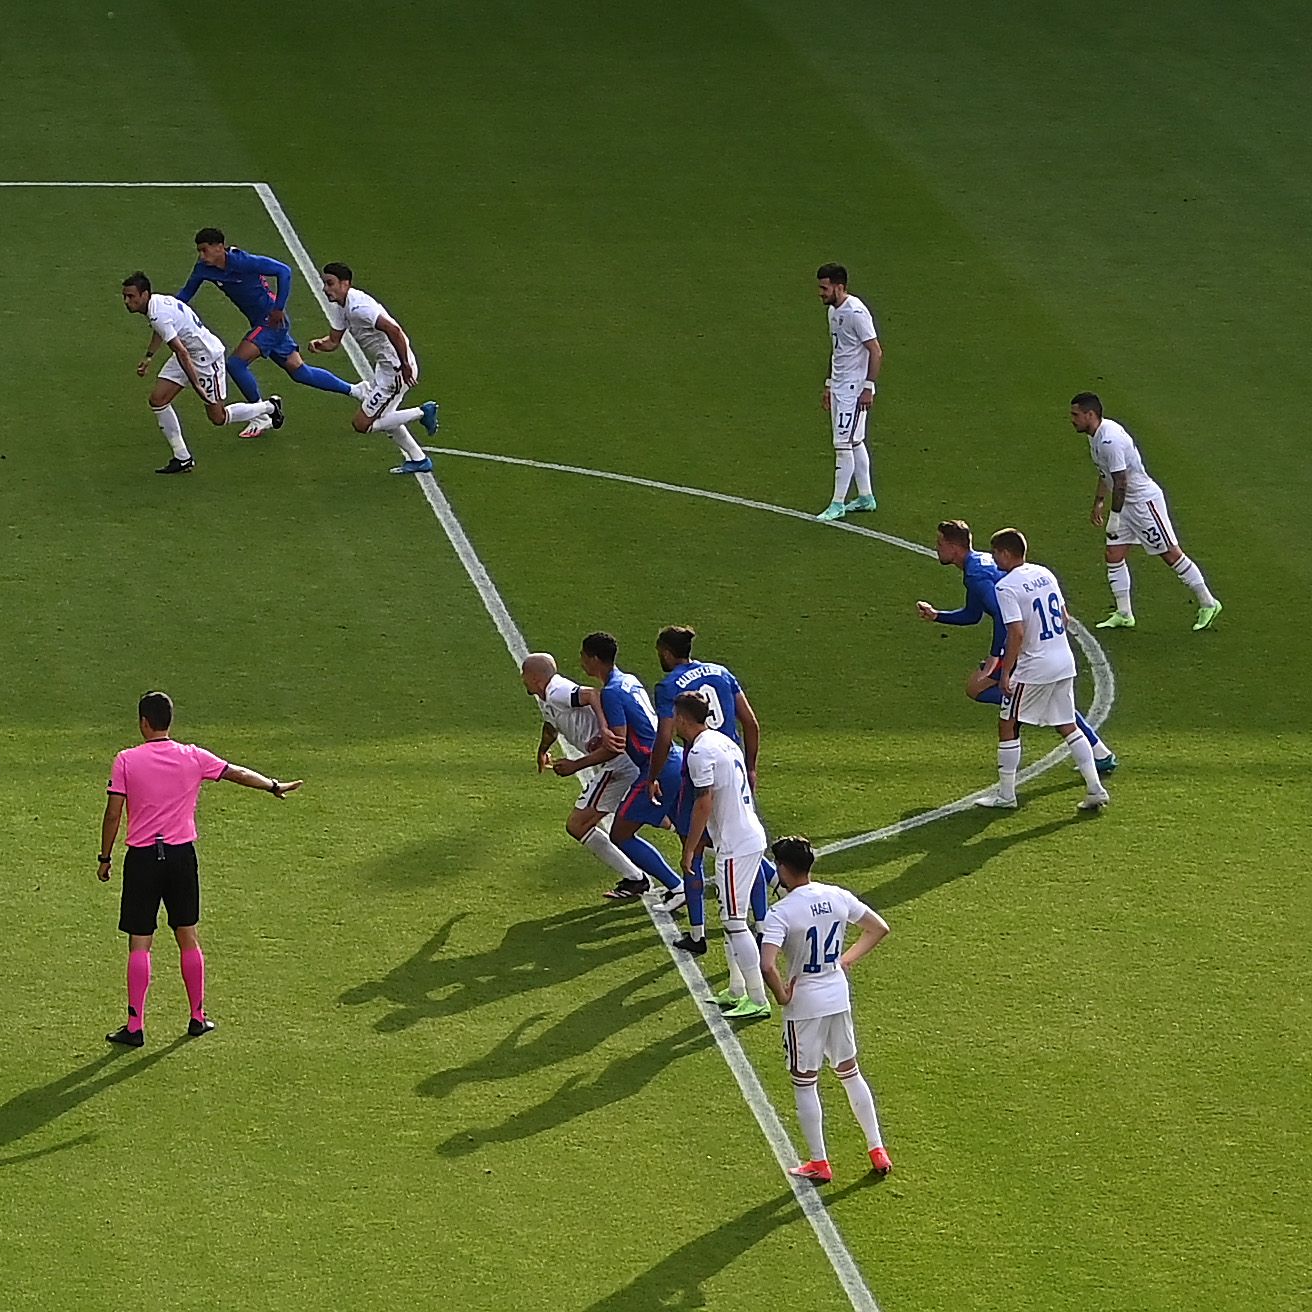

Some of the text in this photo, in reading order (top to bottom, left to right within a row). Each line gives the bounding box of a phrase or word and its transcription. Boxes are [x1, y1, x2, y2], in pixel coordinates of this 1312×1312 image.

[837, 412, 853, 429] 17
[1141, 526, 1162, 544] 23
[1032, 592, 1065, 641] 18
[802, 920, 842, 974] 14
